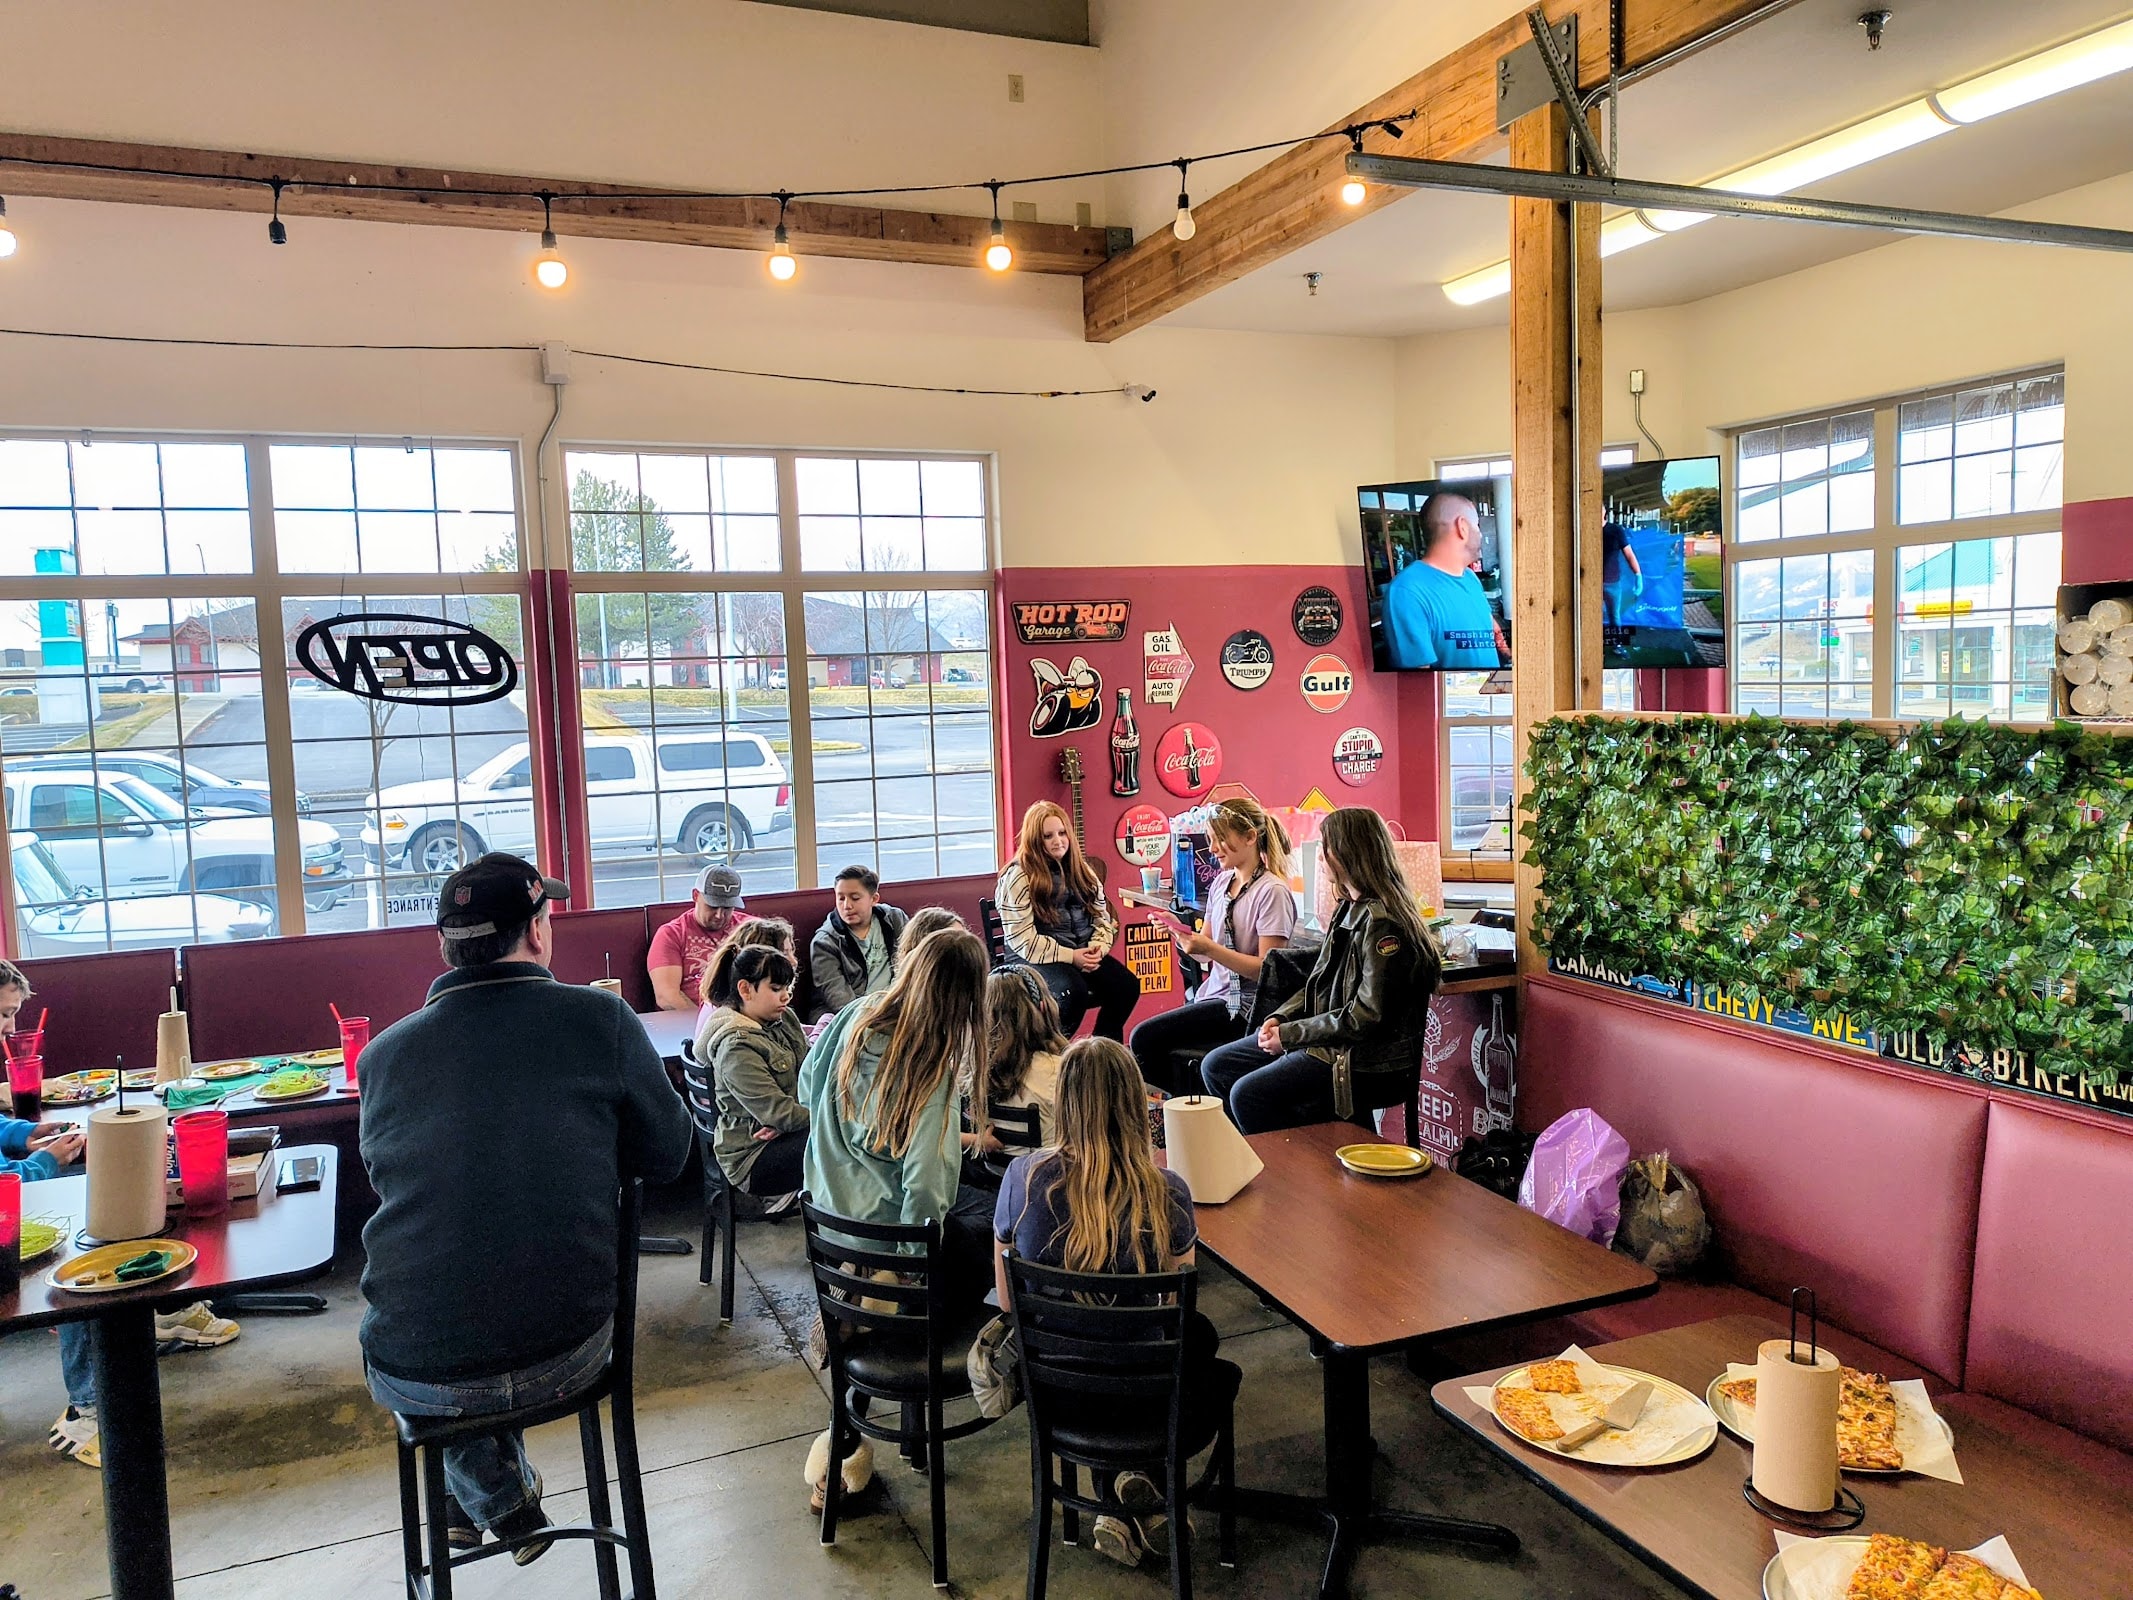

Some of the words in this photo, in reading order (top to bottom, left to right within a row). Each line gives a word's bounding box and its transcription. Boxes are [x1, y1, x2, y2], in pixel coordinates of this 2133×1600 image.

[1016, 604, 1072, 625] HOT
[1073, 603, 1127, 623] ROD
[1024, 624, 1072, 640] Garage
[1152, 635, 1171, 643] GAS
[1449, 631, 1495, 640] Smashing
[1152, 643, 1170, 653] OIL
[1230, 667, 1267, 679] TRIUMPH
[1151, 682, 1174, 690] AUTO
[1303, 675, 1350, 692] Gulf
[1151, 689, 1174, 697] REPAIRS
[1341, 739, 1373, 752] STUPID
[1342, 760, 1377, 775] CHARGE
[1128, 944, 1168, 961] CHILDISH
[1135, 960, 1163, 976] ADULT
[1145, 975, 1168, 990] PLAY
[1703, 986, 1775, 1025] CHEVY
[1893, 1030, 1944, 1066] OLD
[1418, 1091, 1453, 1123] EEP
